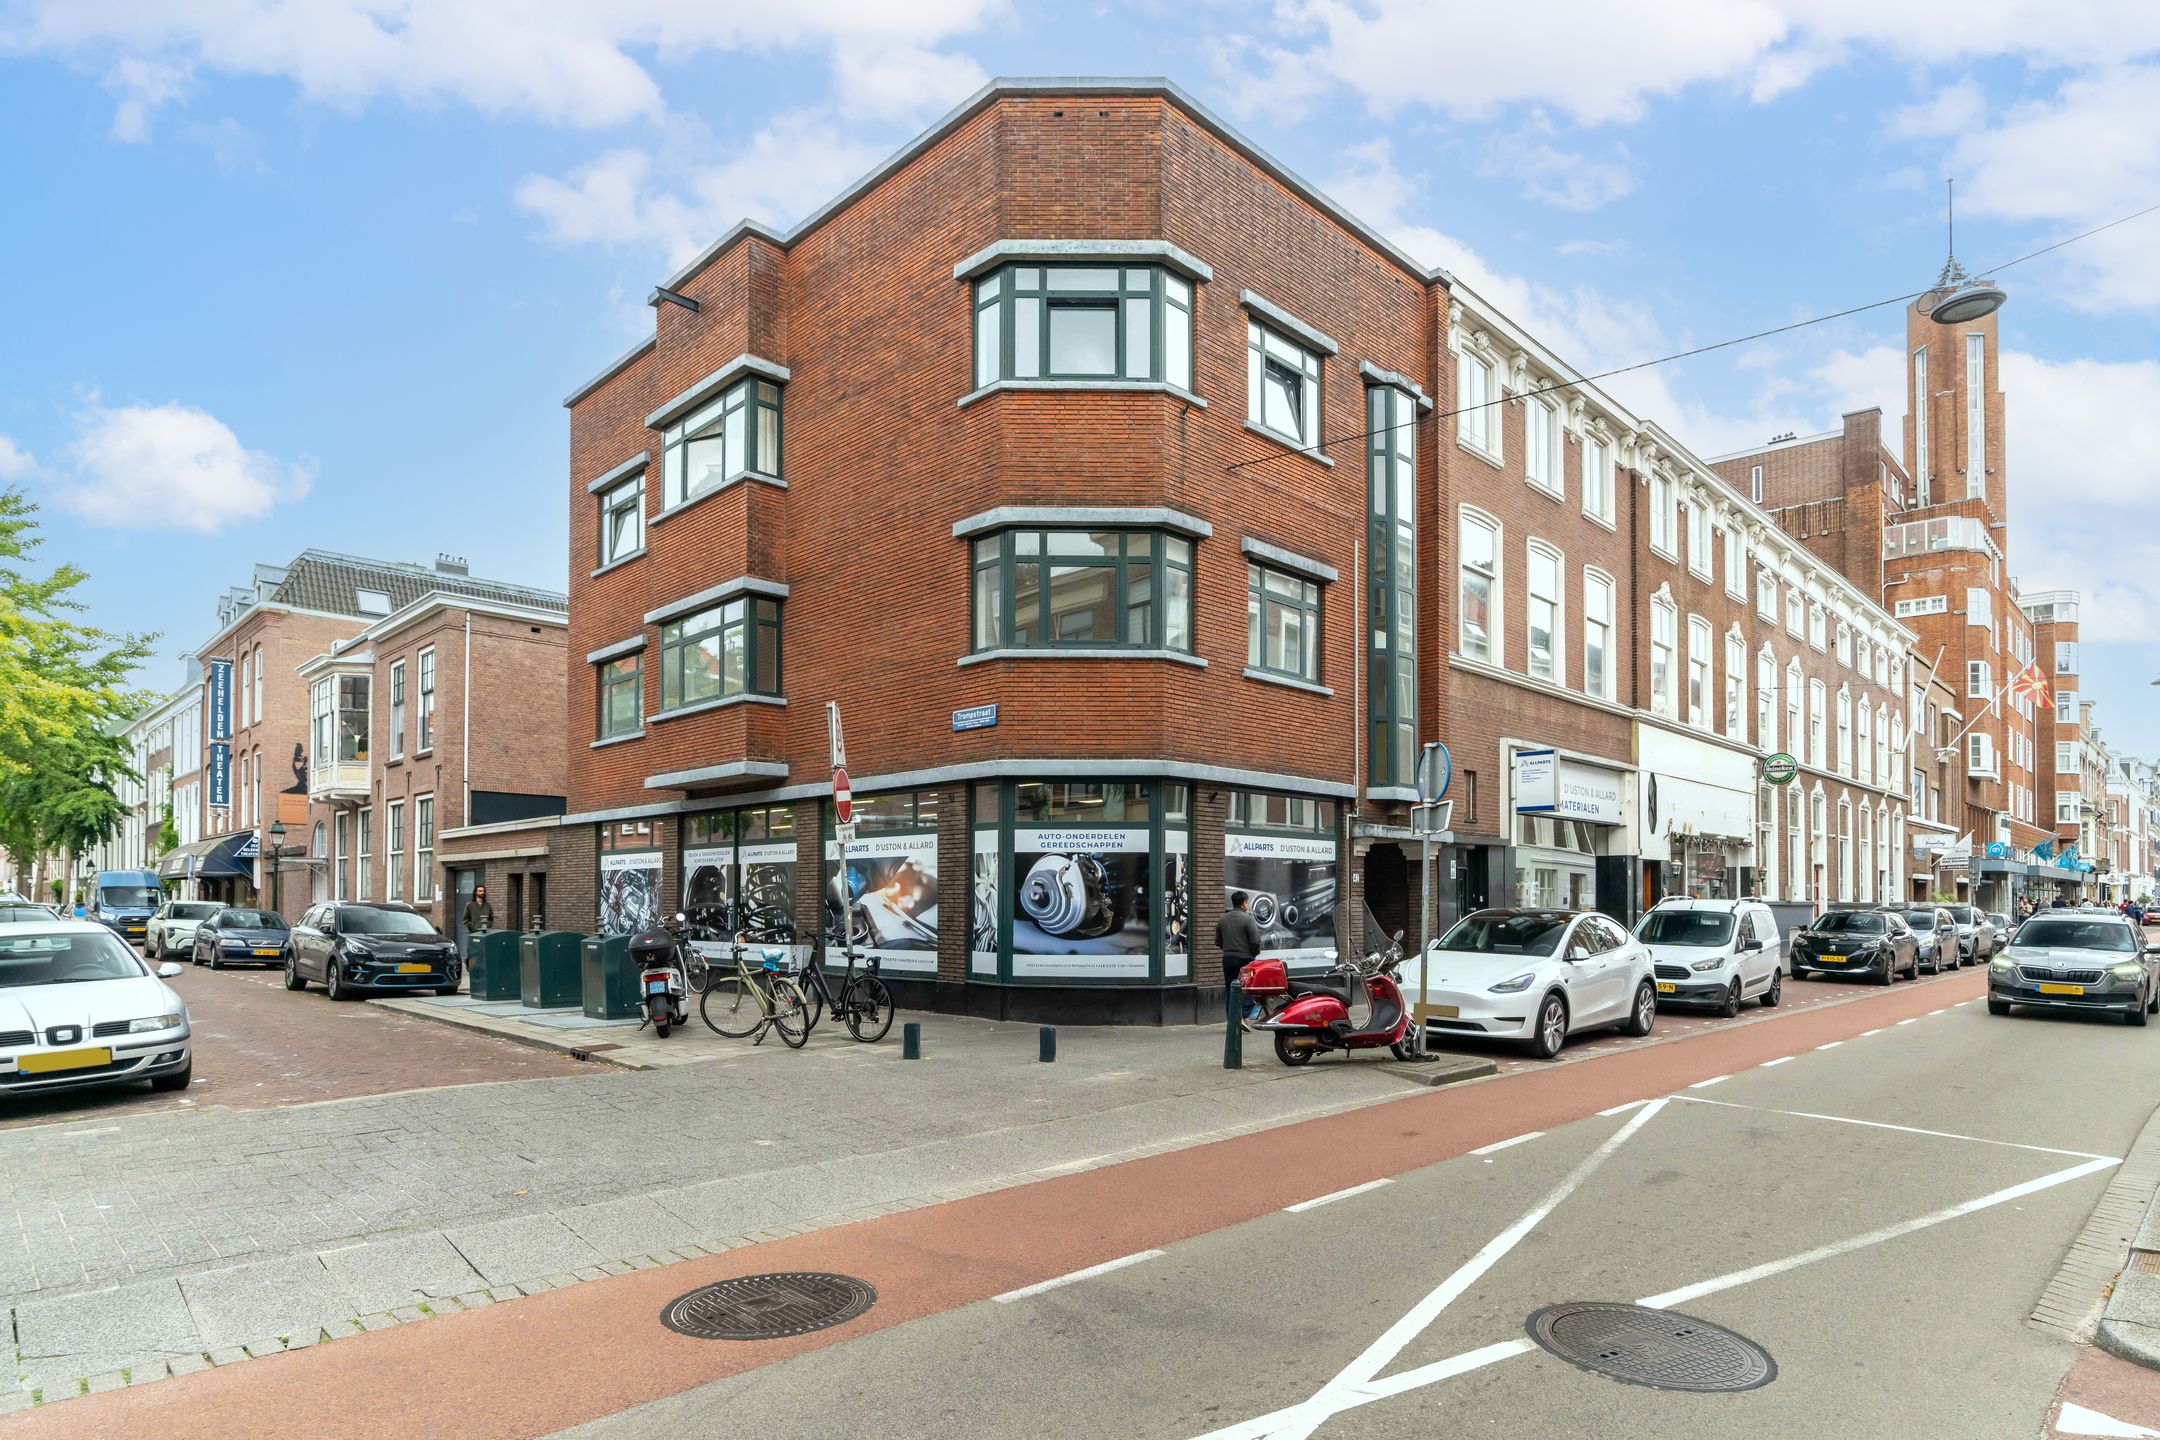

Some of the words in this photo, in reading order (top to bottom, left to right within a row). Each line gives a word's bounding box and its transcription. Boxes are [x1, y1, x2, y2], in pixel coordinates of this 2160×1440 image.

[217, 665, 225, 738] ZEEHELDEN
[957, 709, 991, 720] Trompstraat
[216, 745, 224, 802] THEATER
[1564, 784, 1589, 797] D'USTON
[1595, 789, 1616, 801] ALLARD
[1560, 799, 1600, 814] MATERIALEN
[845, 844, 870, 853] LLPARTS
[875, 842, 902, 851] D'USTON
[908, 841, 934, 849] ALLARD
[1243, 842, 1274, 852] ALLPARTS
[1280, 844, 1305, 853] D'USTON
[1311, 846, 1333, 855] ALLARD
[609, 858, 626, 866] ALLPARTS
[628, 857, 645, 865] D'USTON
